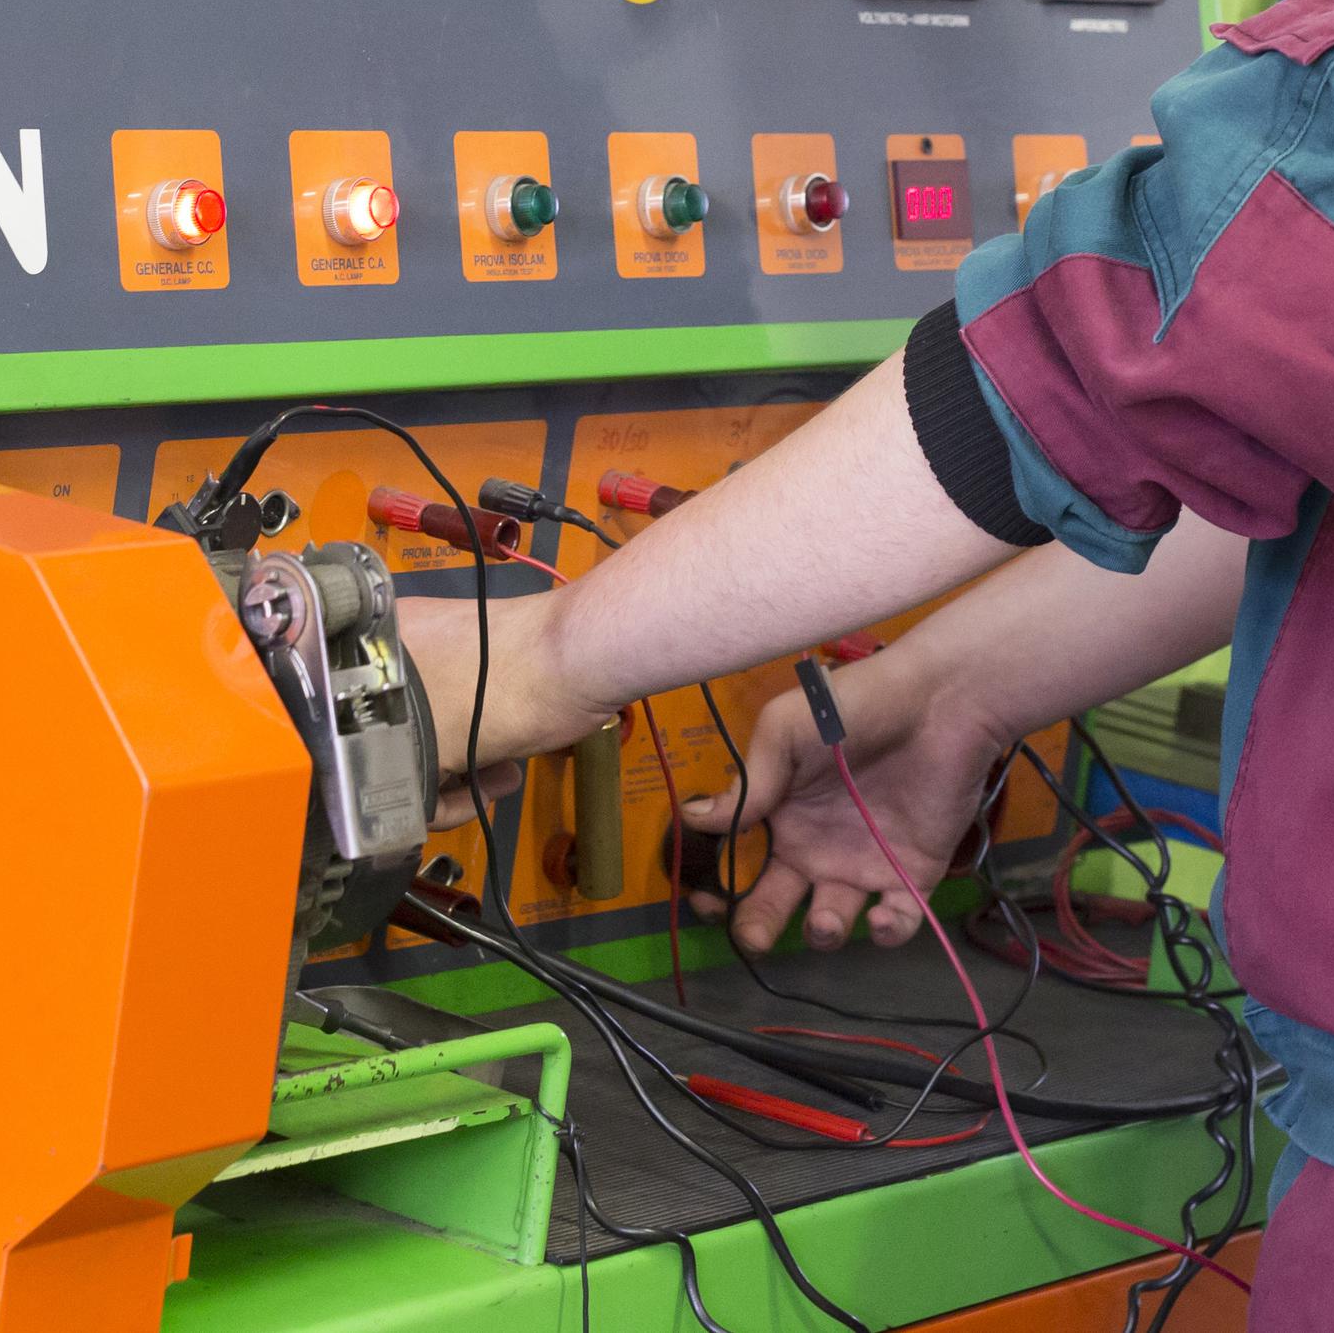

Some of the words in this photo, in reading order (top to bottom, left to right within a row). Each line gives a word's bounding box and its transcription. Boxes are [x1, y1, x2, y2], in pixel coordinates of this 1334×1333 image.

[474, 254, 505, 267] PROVA
[633, 251, 661, 263] PROVA
[135, 261, 194, 276] GENERALE
[196, 261, 216, 274] C.C.
[311, 257, 365, 272] GENERALE
[53, 484, 71, 497] ON
[402, 547, 432, 560] PROVA
